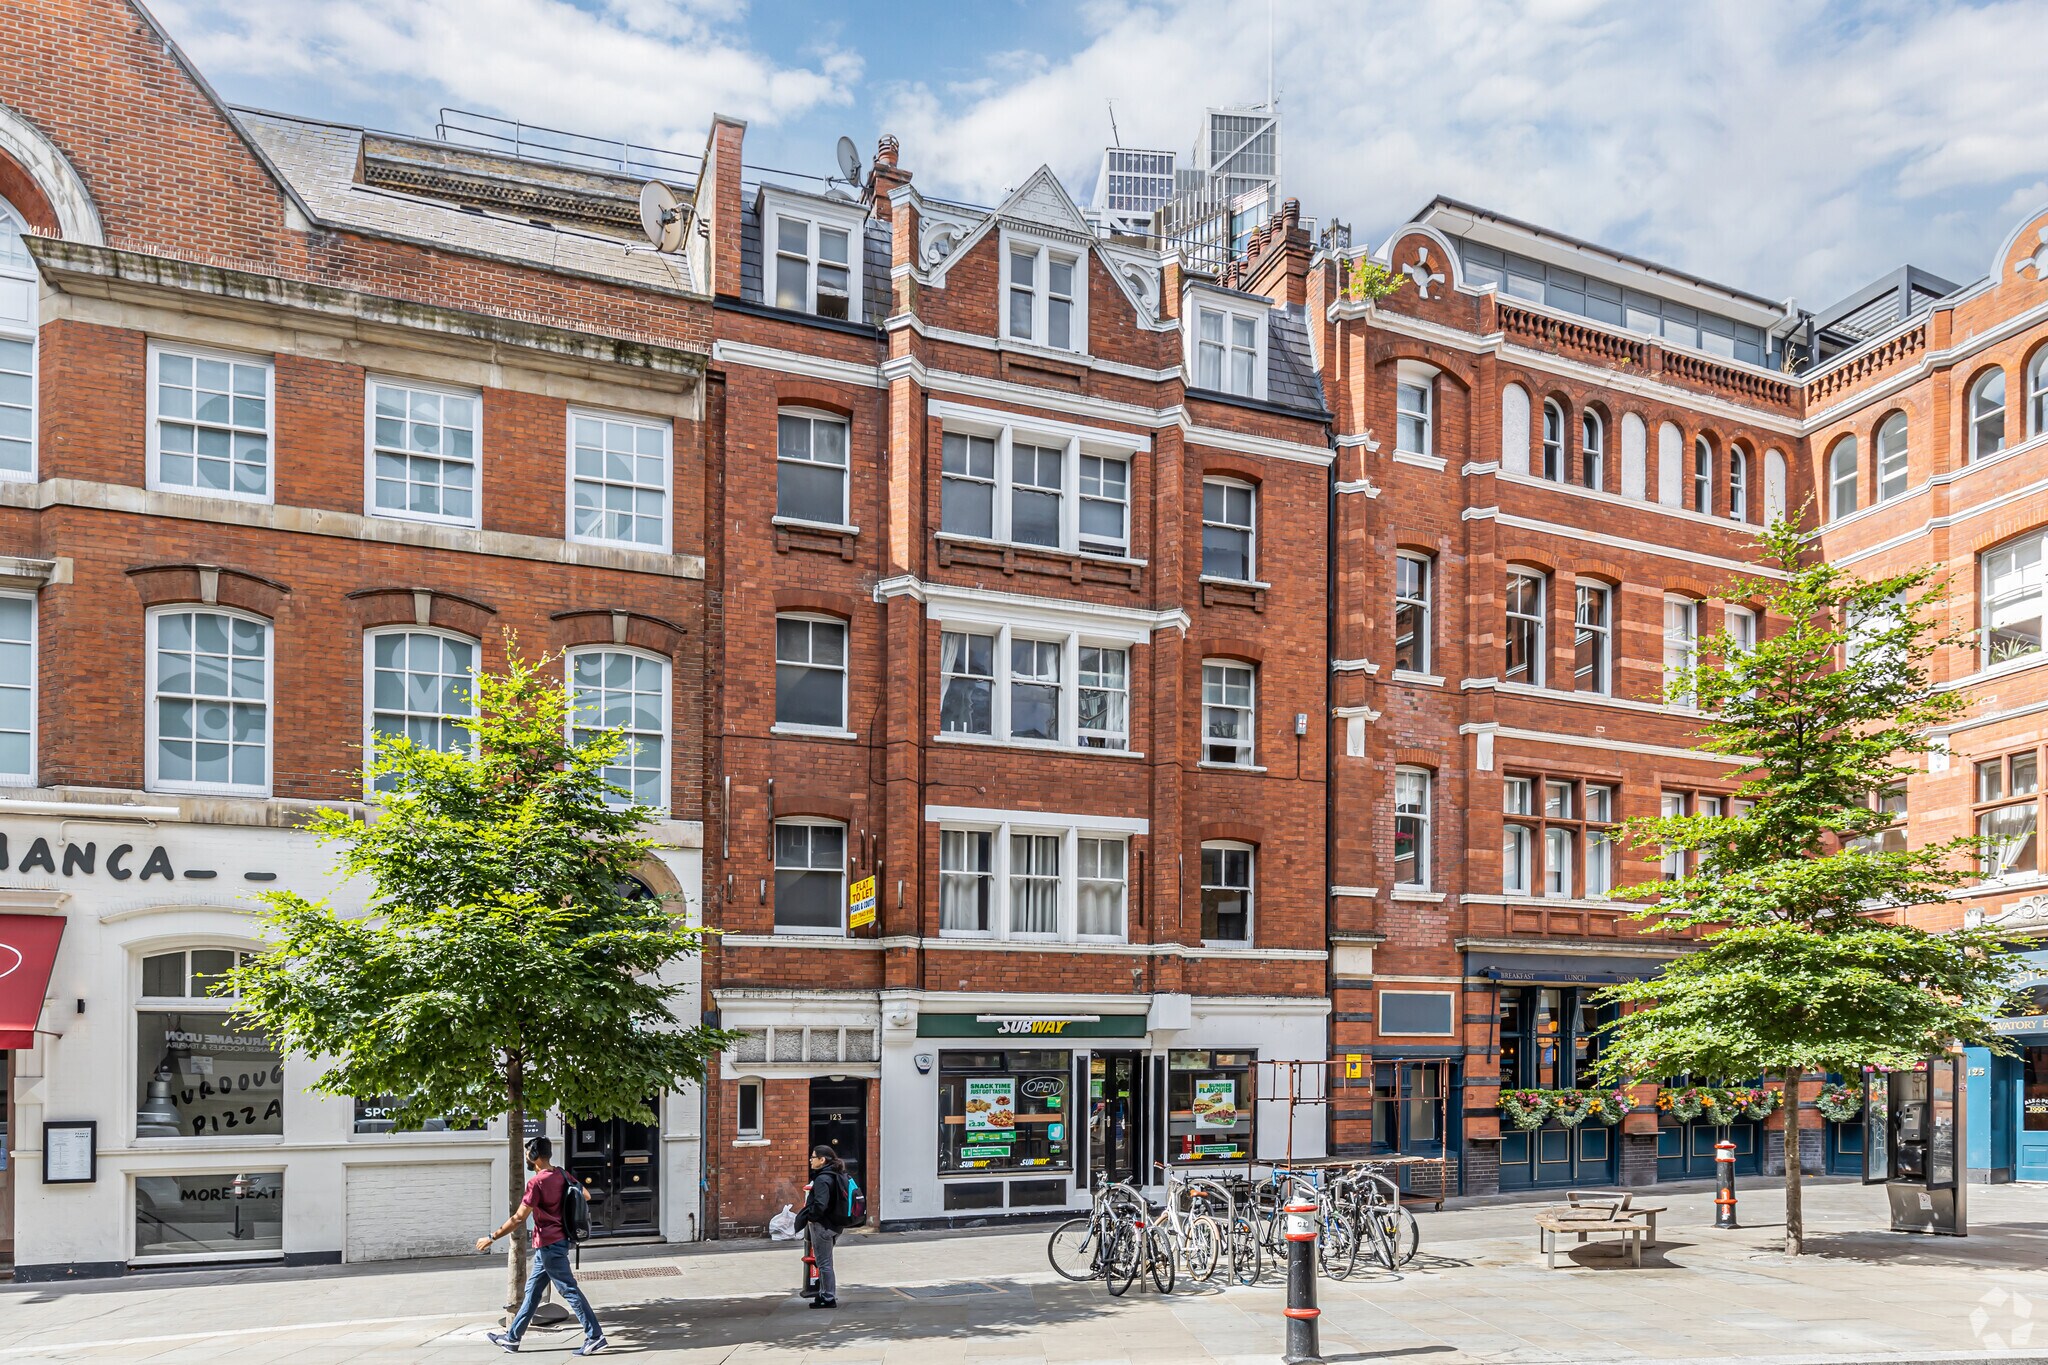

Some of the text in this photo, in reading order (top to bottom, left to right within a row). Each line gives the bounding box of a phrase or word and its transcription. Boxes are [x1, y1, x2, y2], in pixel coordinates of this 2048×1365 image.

[1501, 972, 1535, 980] BREAKFAST
[1564, 974, 1587, 982] LUNCH
[997, 1020, 1071, 1034] SUBWAY
[1026, 1081, 1059, 1093] OPEN
[192, 1098, 281, 1136] PIZZA
[829, 1113, 842, 1121] 123
[1219, 1151, 1246, 1159] SUBWAY
[959, 1160, 990, 1168] SUBWAY
[1020, 1158, 1050, 1166] SUBWAY
[181, 1187, 231, 1201] MORE
